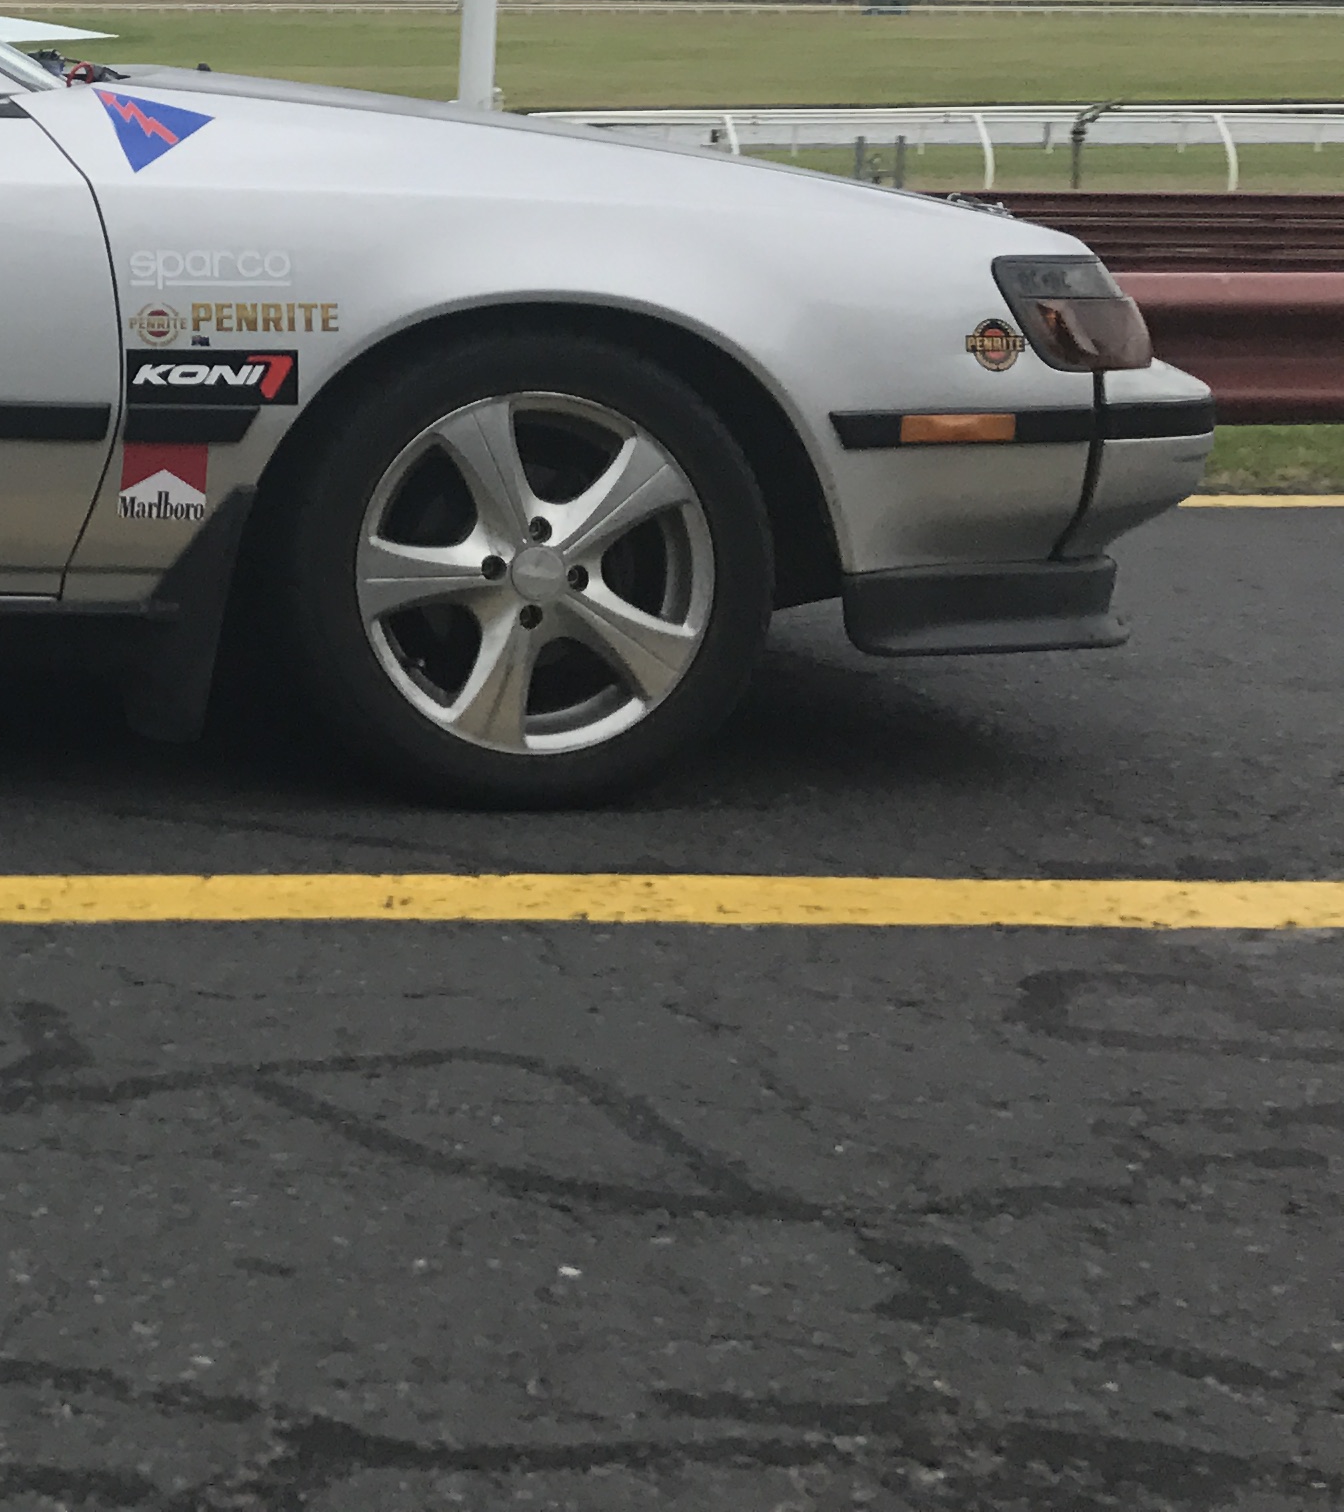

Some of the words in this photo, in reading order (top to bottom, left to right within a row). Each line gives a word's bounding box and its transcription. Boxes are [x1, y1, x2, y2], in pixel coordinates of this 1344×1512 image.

[129, 249, 292, 289] sparco
[191, 303, 339, 332] PENRITE
[967, 337, 1024, 350] PENRITE
[132, 364, 265, 386] KONI
[118, 490, 204, 519] Marlboro
